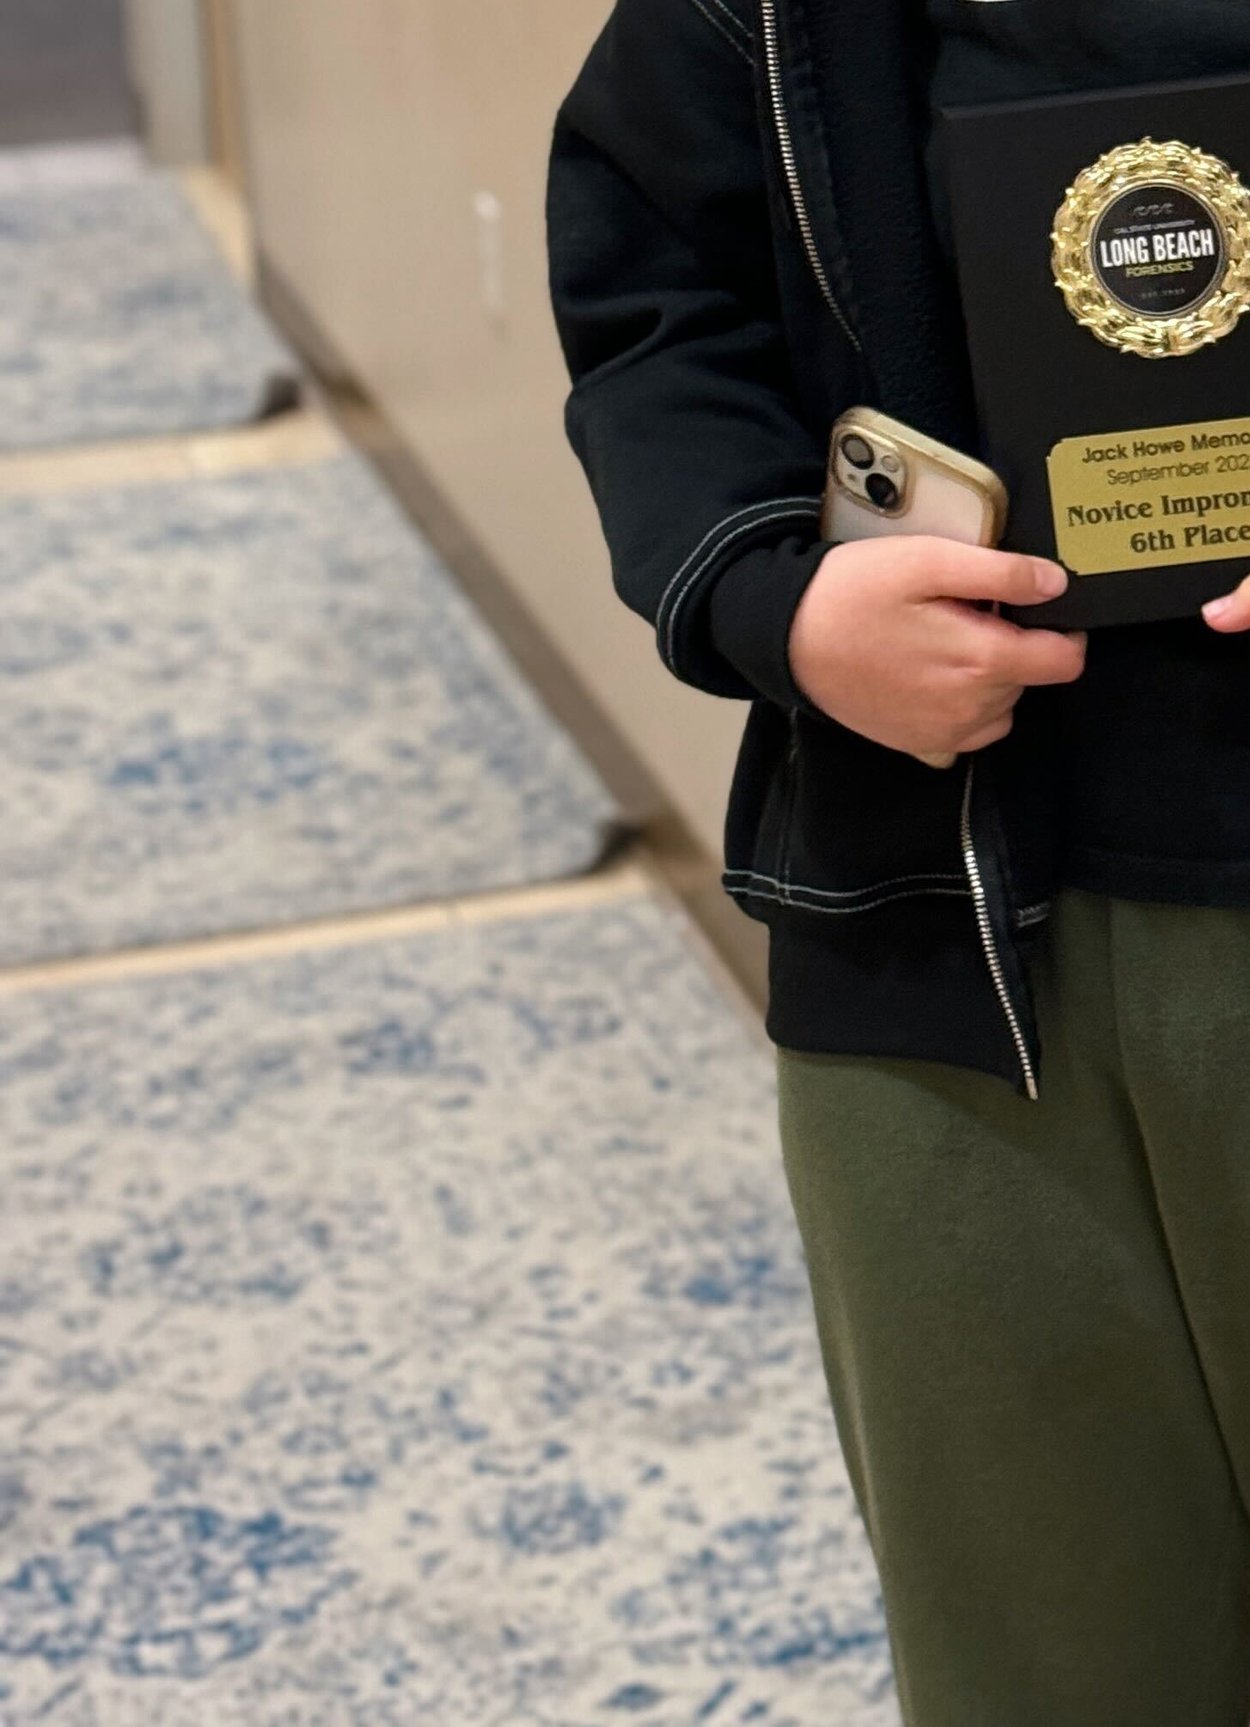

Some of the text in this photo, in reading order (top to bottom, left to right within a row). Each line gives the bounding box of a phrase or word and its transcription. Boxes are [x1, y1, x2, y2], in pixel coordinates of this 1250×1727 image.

[1099, 228, 1216, 268] LONG BEACH
[1125, 260, 1195, 278] FORENSICS
[1082, 442, 1128, 464] Jack
[1133, 437, 1186, 457] Howe
[1107, 457, 1210, 487] September
[1067, 500, 1153, 528] Novice
[1130, 529, 1176, 554] 6th
